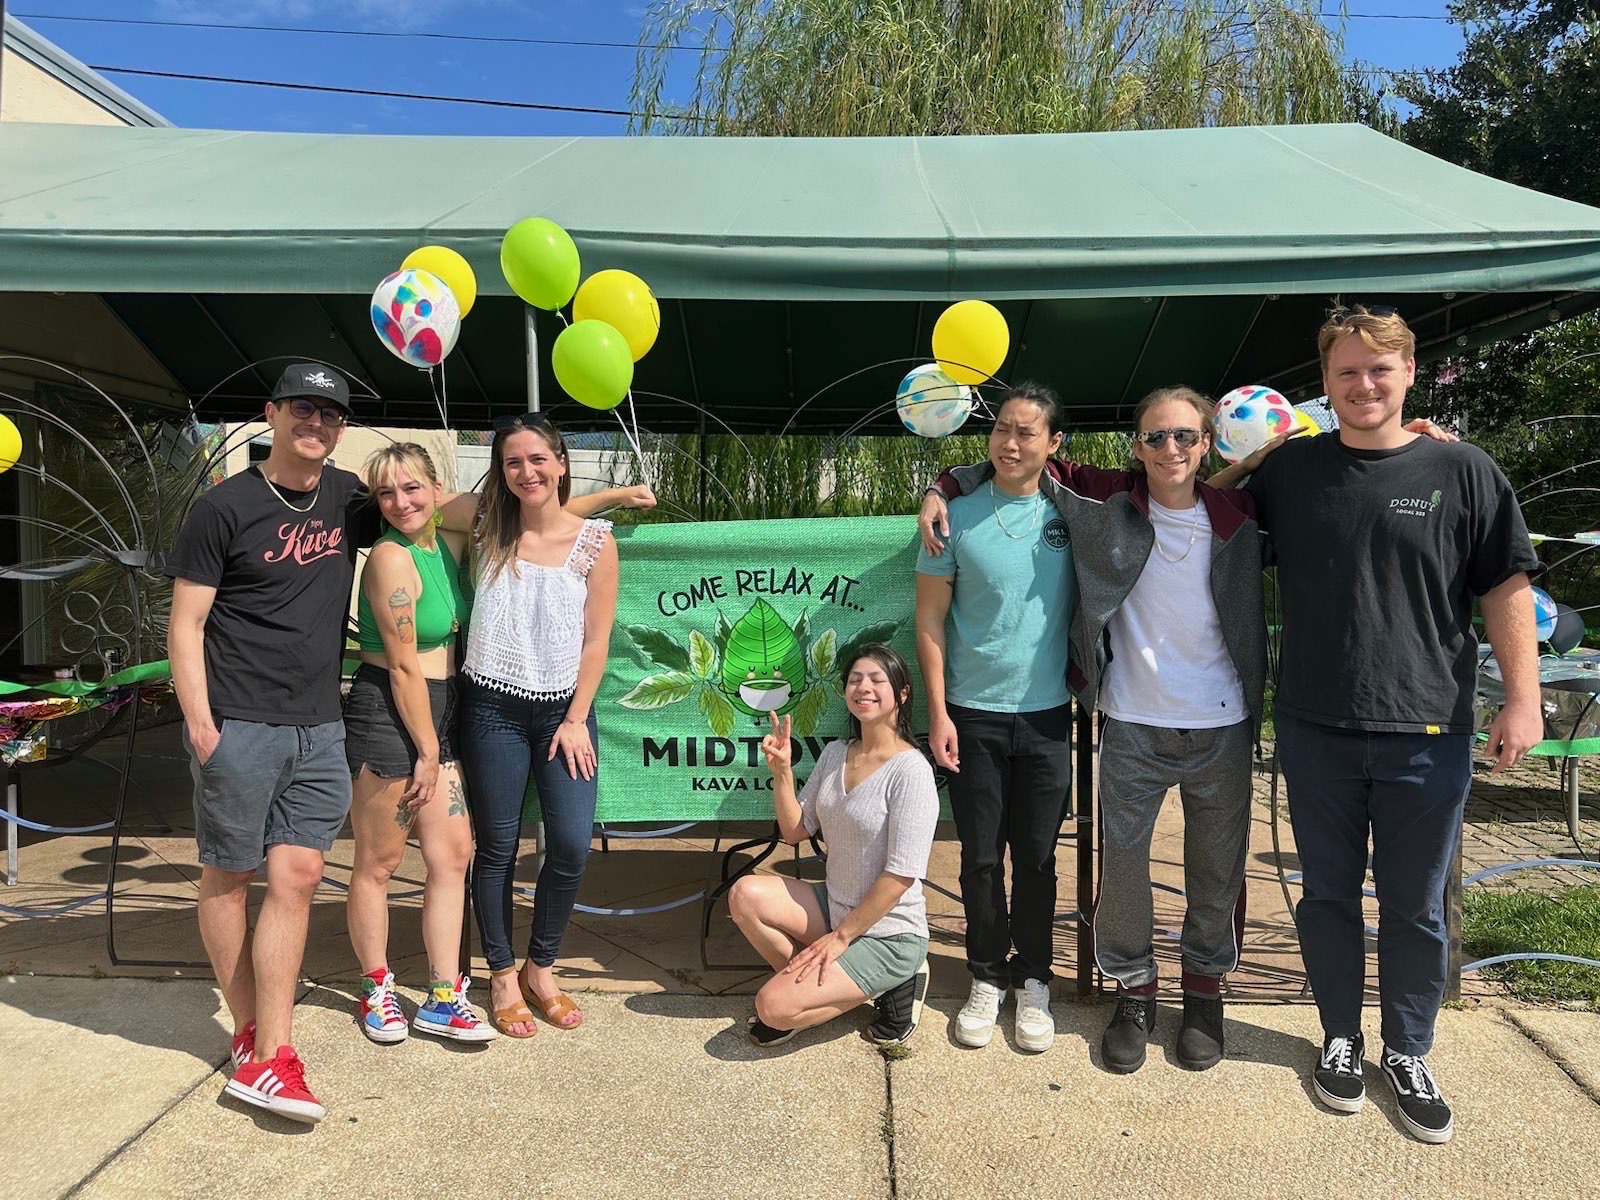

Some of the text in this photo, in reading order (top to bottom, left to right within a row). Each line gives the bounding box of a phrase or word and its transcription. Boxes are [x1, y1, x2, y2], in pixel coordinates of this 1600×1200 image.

[1389, 498, 1436, 512] DONUT
[264, 518, 343, 566] Kava
[1047, 528, 1067, 537] MKL
[657, 566, 865, 616] COME RELAX AT...
[642, 736, 839, 768] MIDT
[692, 777, 748, 791] KAVA
